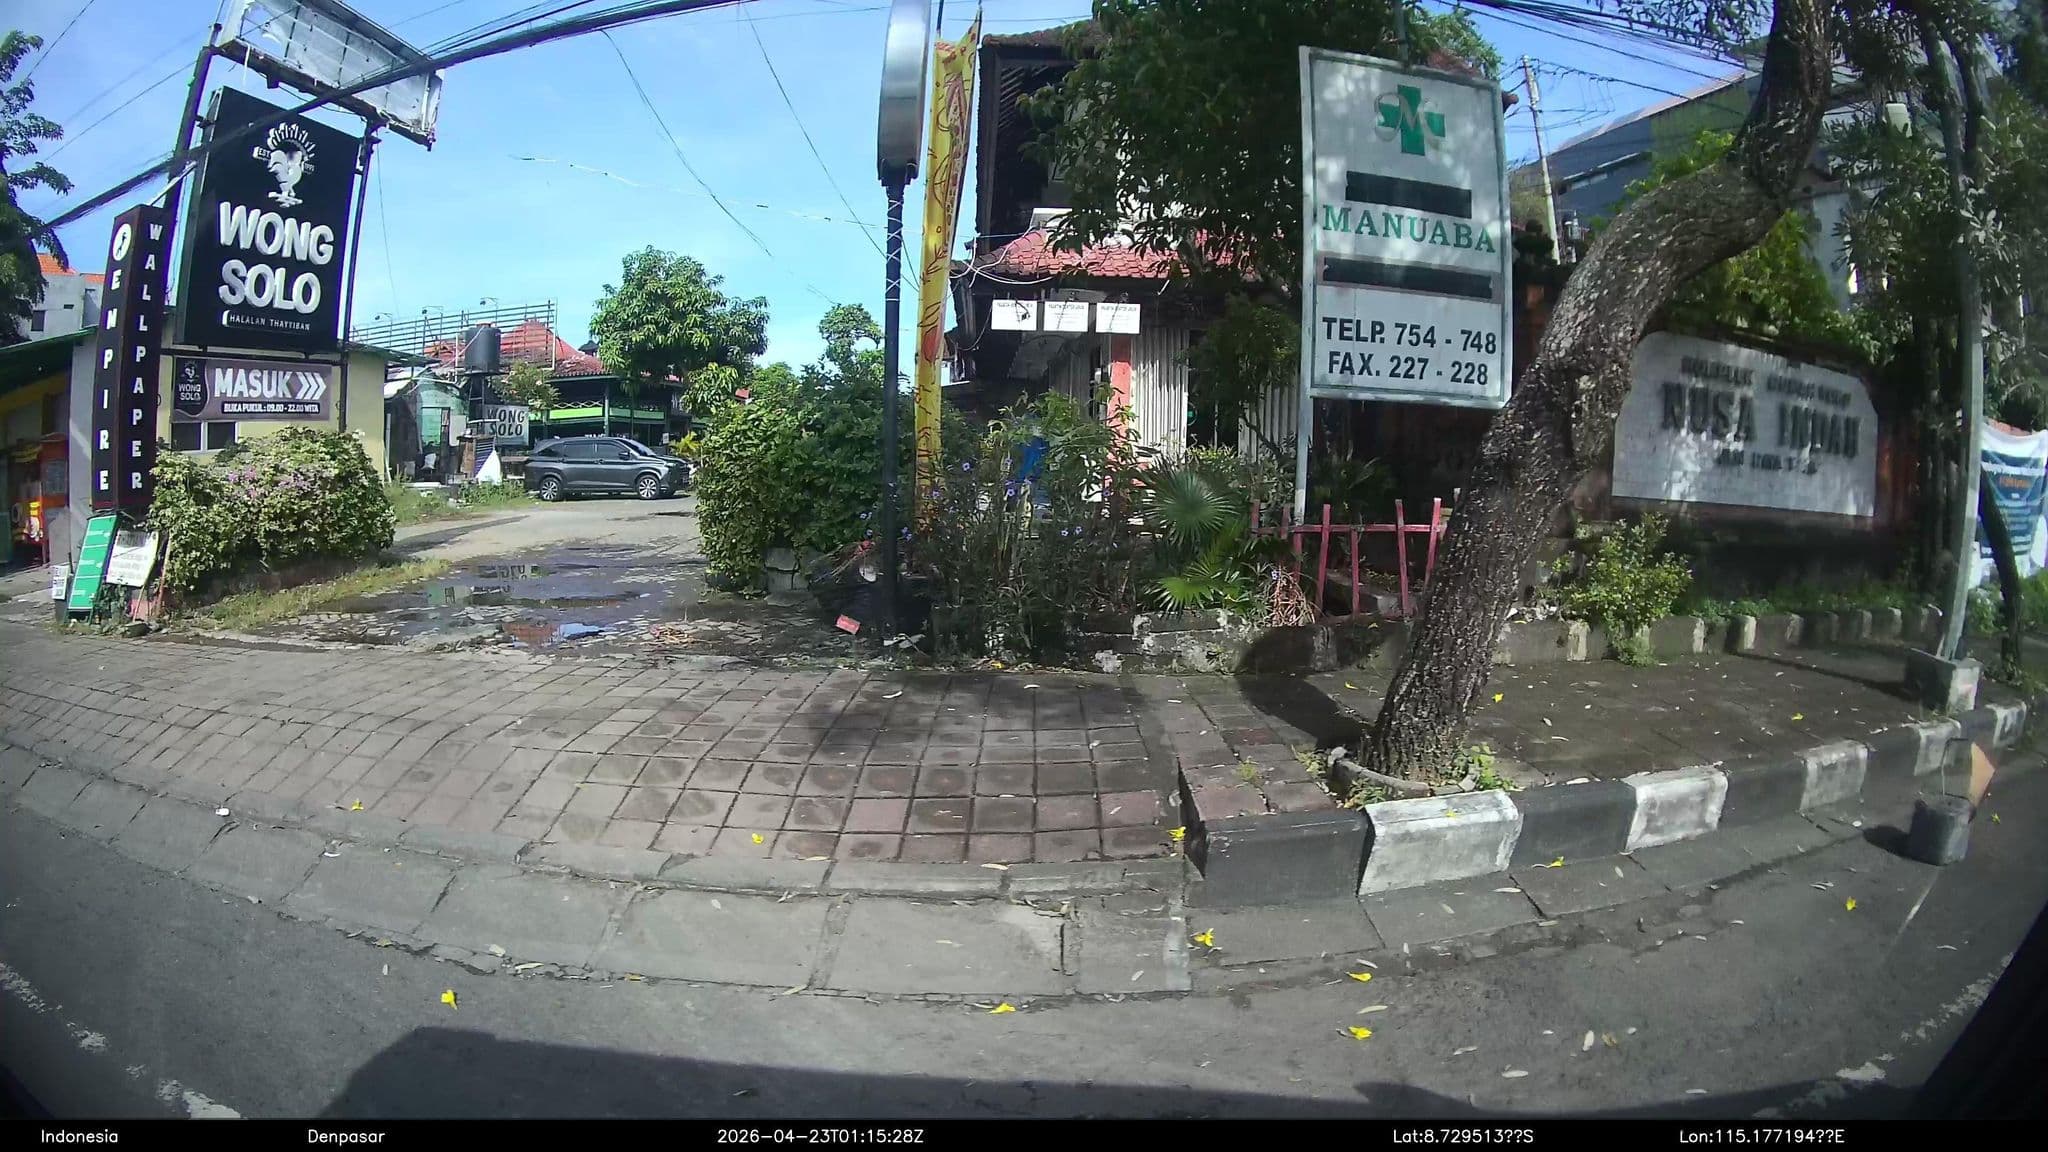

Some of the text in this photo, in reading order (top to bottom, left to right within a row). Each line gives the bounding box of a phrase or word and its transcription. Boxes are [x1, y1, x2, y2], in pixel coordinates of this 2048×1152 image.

[220, 201, 334, 265] WONG
[1322, 204, 1496, 253] MANUABA
[218, 259, 321, 314] SOLO
[229, 314, 266, 326] HALALAN
[1322, 316, 1385, 344] TELP.
[1394, 322, 1436, 348] 754
[1460, 329, 1497, 354] 748
[131, 223, 163, 490] WALLPAPER
[1328, 351, 1381, 377] FAX.
[1389, 355, 1429, 380] 227
[1450, 361, 1488, 385] 228
[178, 383, 201, 393] WONG
[180, 392, 201, 401] SOLO
[214, 367, 292, 399] MASUK
[488, 408, 525, 423] WONG
[489, 422, 523, 436] SOLO
